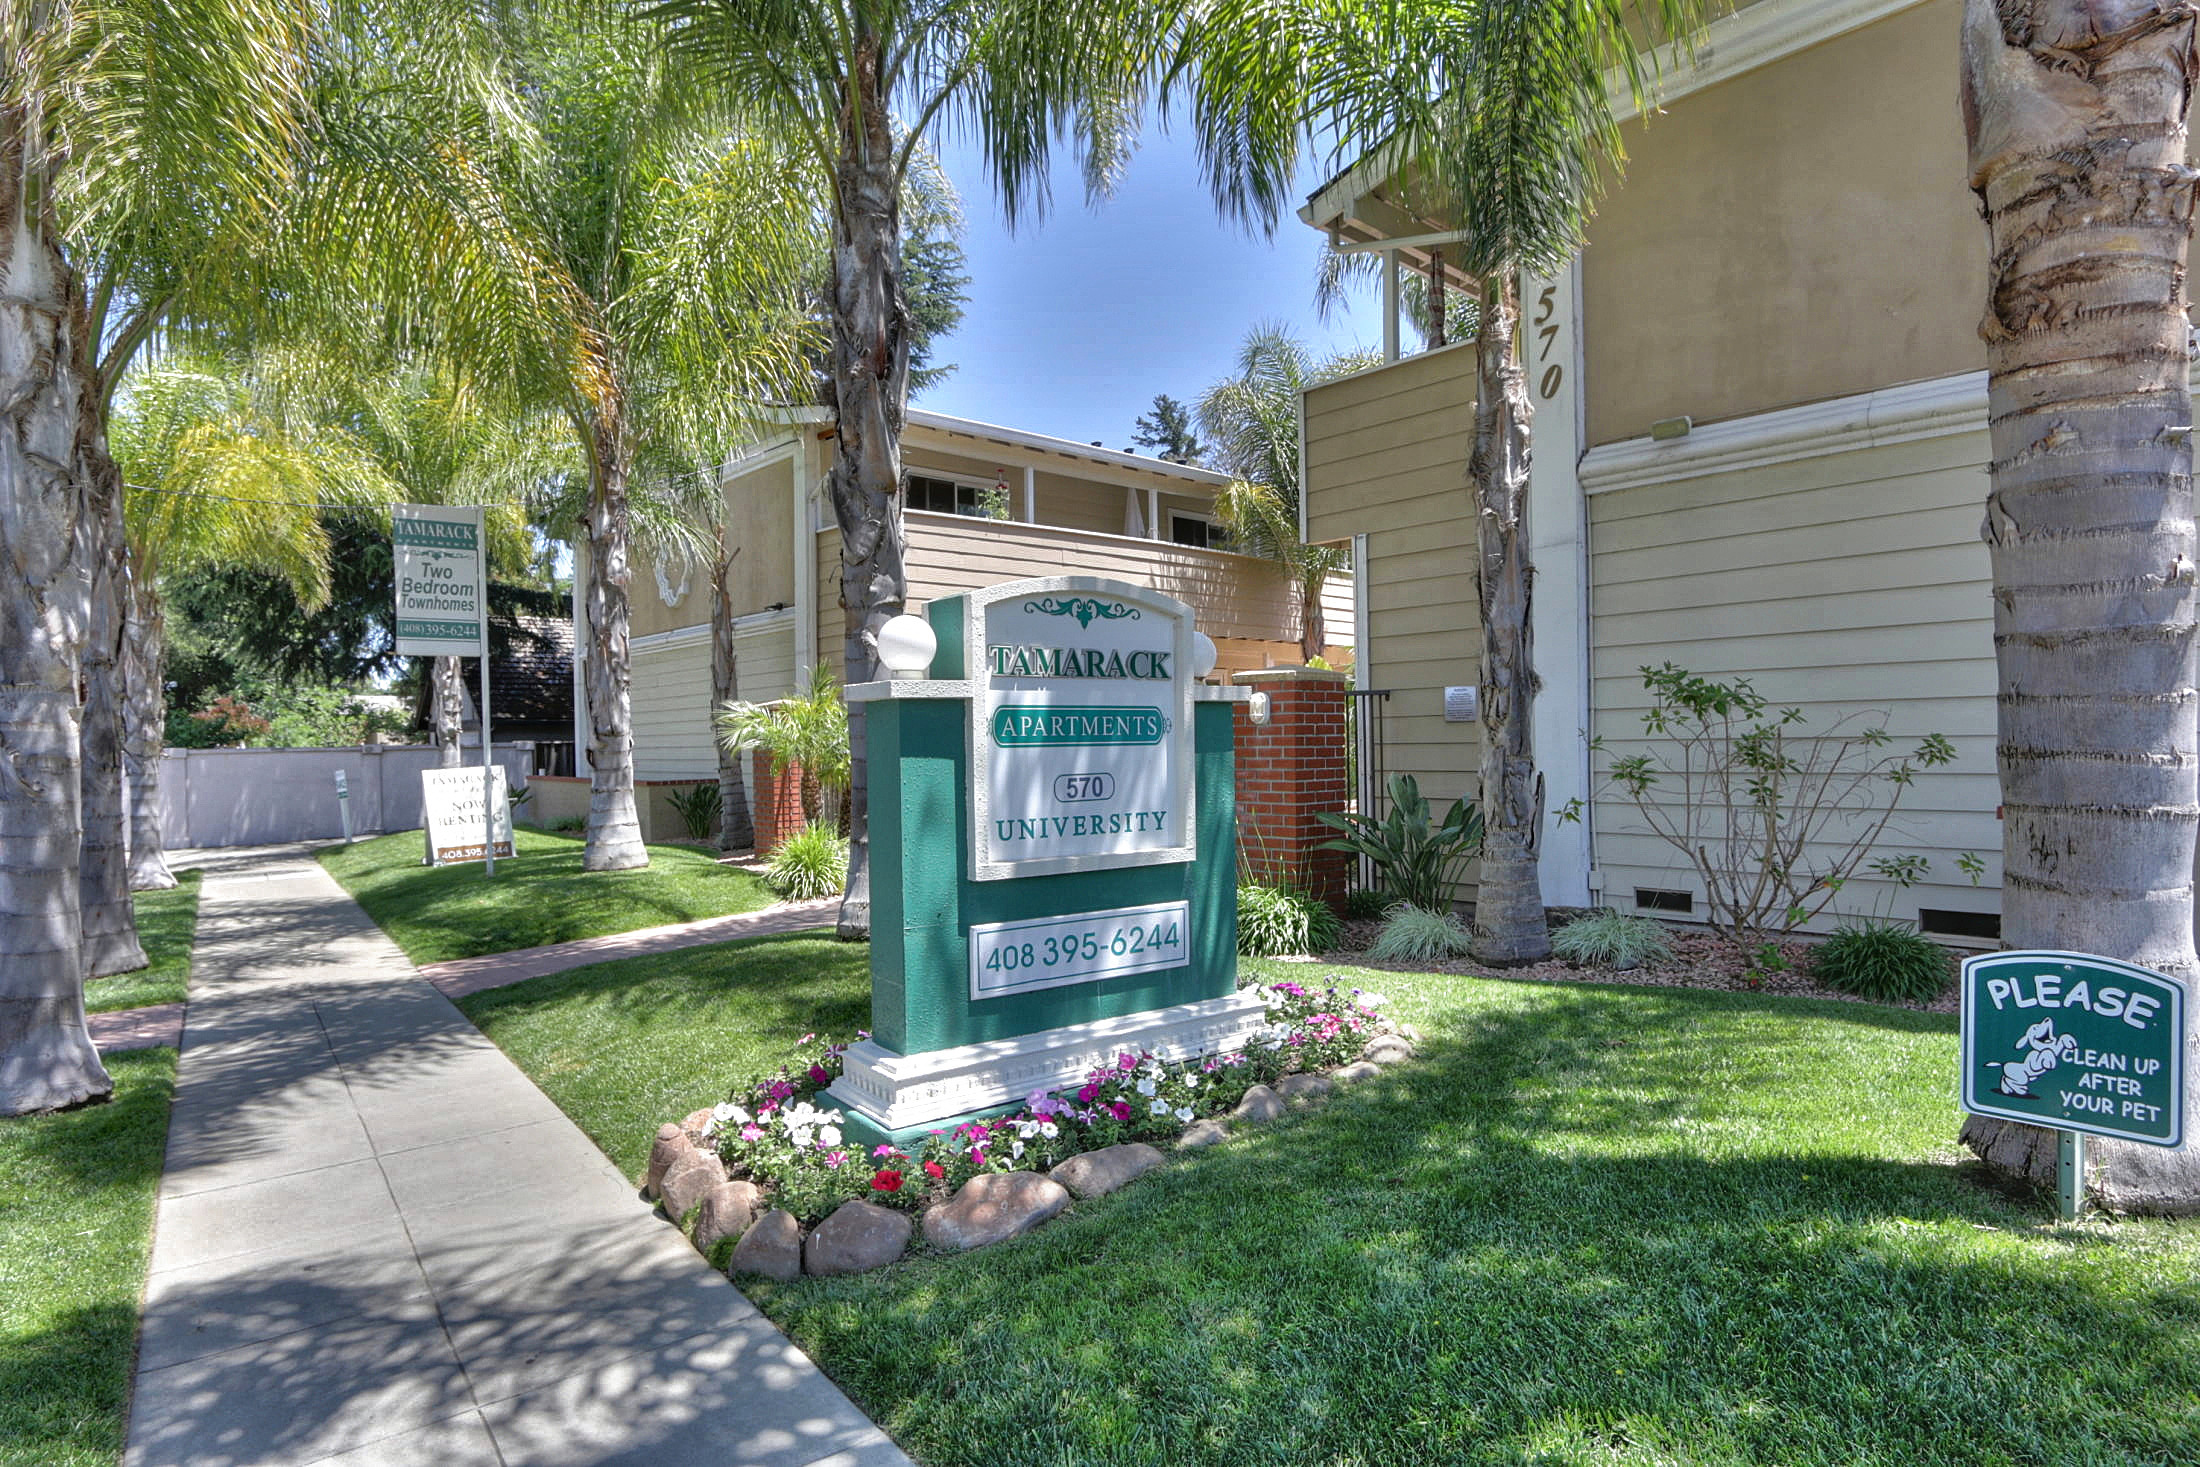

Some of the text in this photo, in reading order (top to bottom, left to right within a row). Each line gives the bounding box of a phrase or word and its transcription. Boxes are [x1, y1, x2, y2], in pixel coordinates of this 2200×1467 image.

[1534, 286, 1562, 399] 570
[398, 521, 473, 540] TAMARACK
[422, 562, 453, 579] Two
[402, 577, 474, 596] Bedroom
[401, 594, 475, 612] Townhomes
[988, 644, 1171, 680] TAMARACK
[1001, 715, 1158, 738] APARTMENTS
[431, 773, 499, 785] TAMARAK
[1066, 776, 1104, 799] 570
[996, 811, 1167, 841] UNIVERSITY
[986, 922, 1180, 972] 408 395-6244
[1987, 975, 2161, 1030] PLEASE
[2061, 1049, 2160, 1076] CLEAN UP
[2078, 1072, 2142, 1097] AFTER
[2060, 1090, 2161, 1122] YOUR PET
